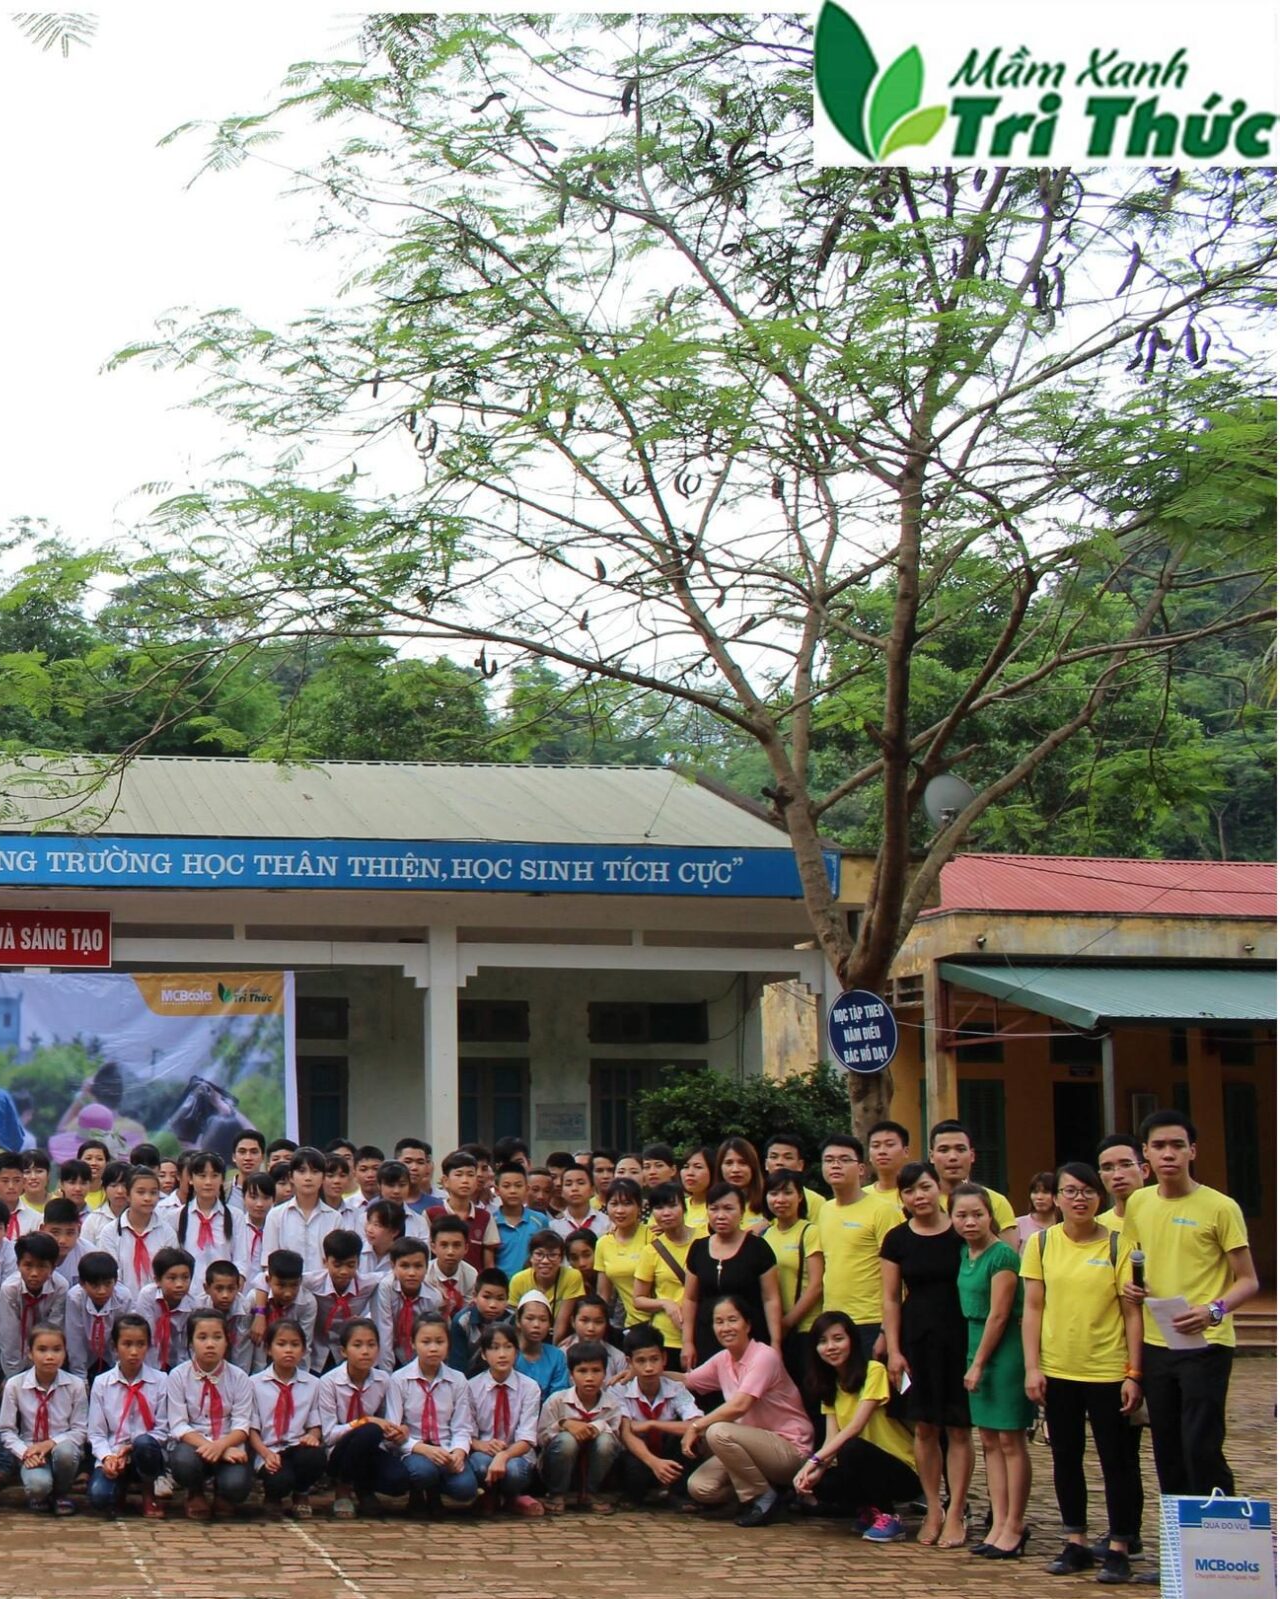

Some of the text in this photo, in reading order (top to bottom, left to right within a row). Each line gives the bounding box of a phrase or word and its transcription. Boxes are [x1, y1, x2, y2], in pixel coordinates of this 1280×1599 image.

[46, 845, 173, 874] TRƯỜNG
[181, 853, 245, 879] HỌC
[253, 850, 339, 877] THÂN
[450, 858, 513, 884] HỌC
[519, 859, 594, 881] SINH
[603, 856, 670, 882] TÍCH
[20, 922, 67, 951] SÁNG
[71, 928, 103, 955] TẠO
[162, 990, 212, 1002] MCBooks
[864, 1004, 884, 1018] THEO
[843, 1046, 860, 1064] BÁC
[872, 1045, 889, 1063] DẠY
[1194, 1558, 1260, 1573] MCBooks
